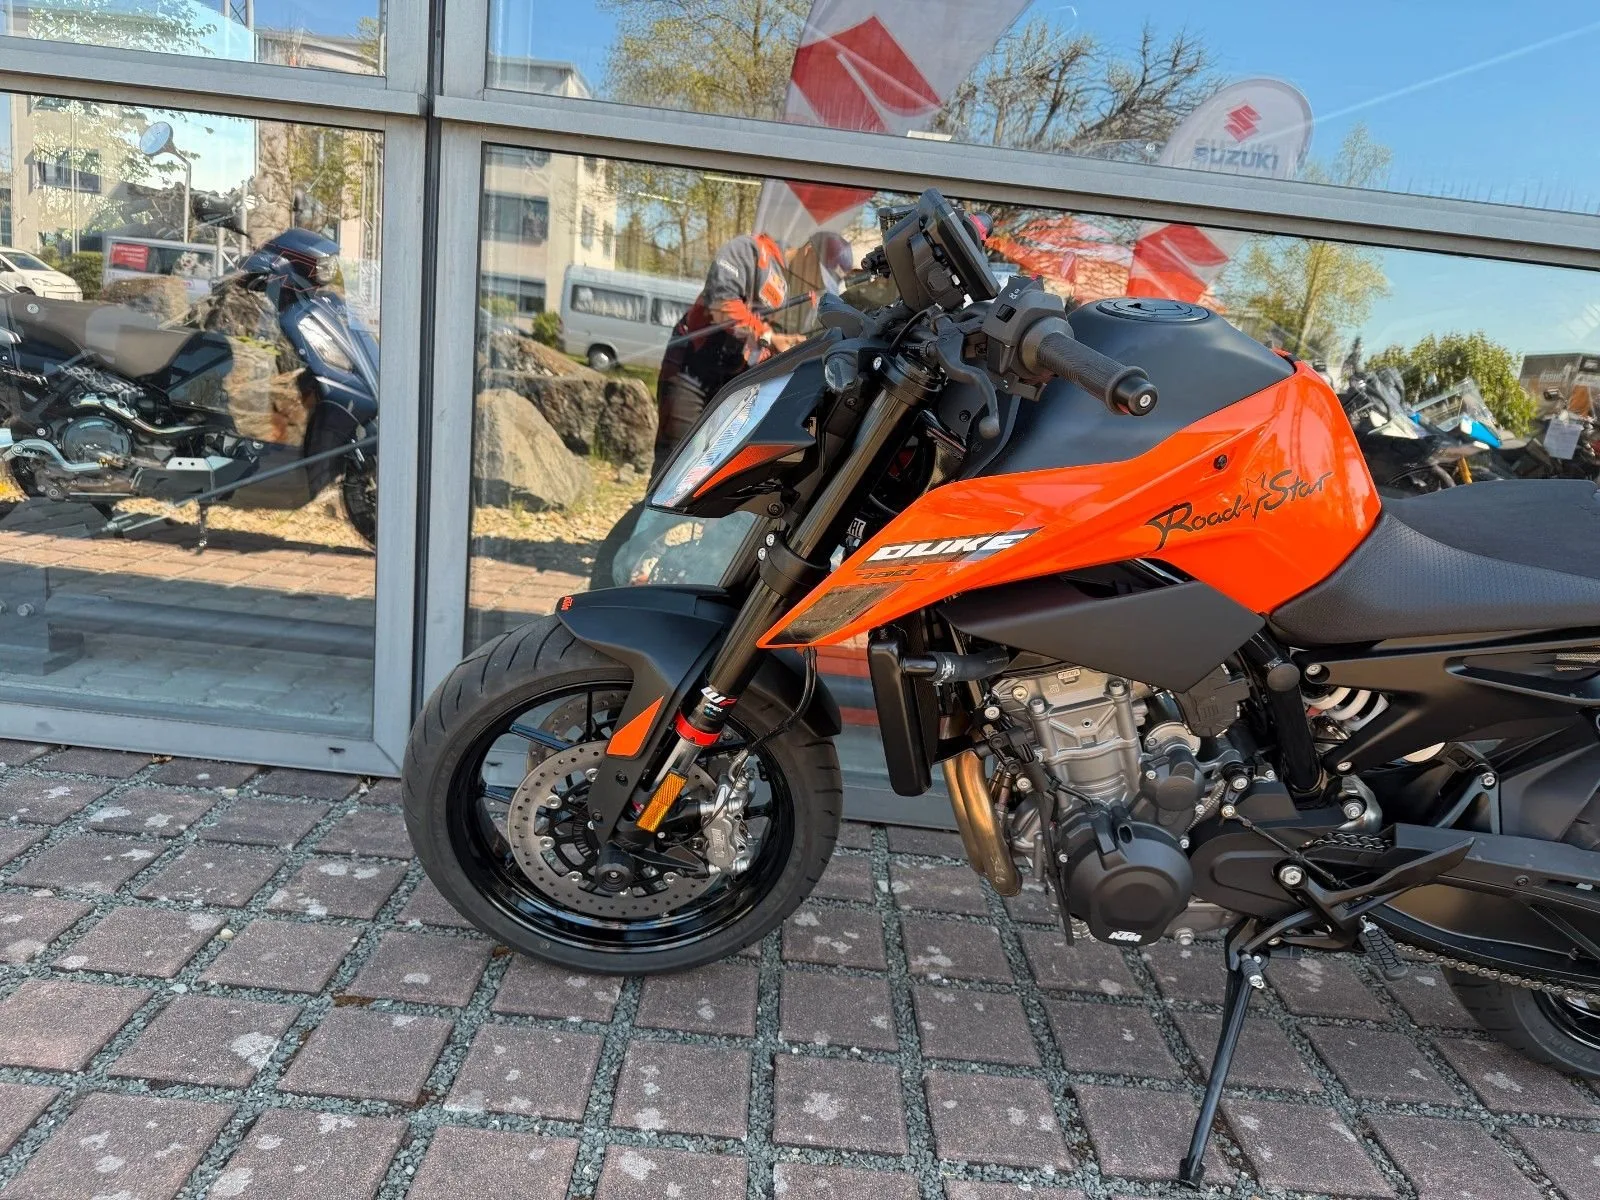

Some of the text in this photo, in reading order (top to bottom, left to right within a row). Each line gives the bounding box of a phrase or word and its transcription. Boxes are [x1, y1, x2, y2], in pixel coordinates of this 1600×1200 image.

[1193, 145, 1279, 169] SUZUKI
[1145, 470, 1334, 552] Road Star
[866, 532, 1030, 562] DUKE
[1108, 930, 1142, 942] KTM
